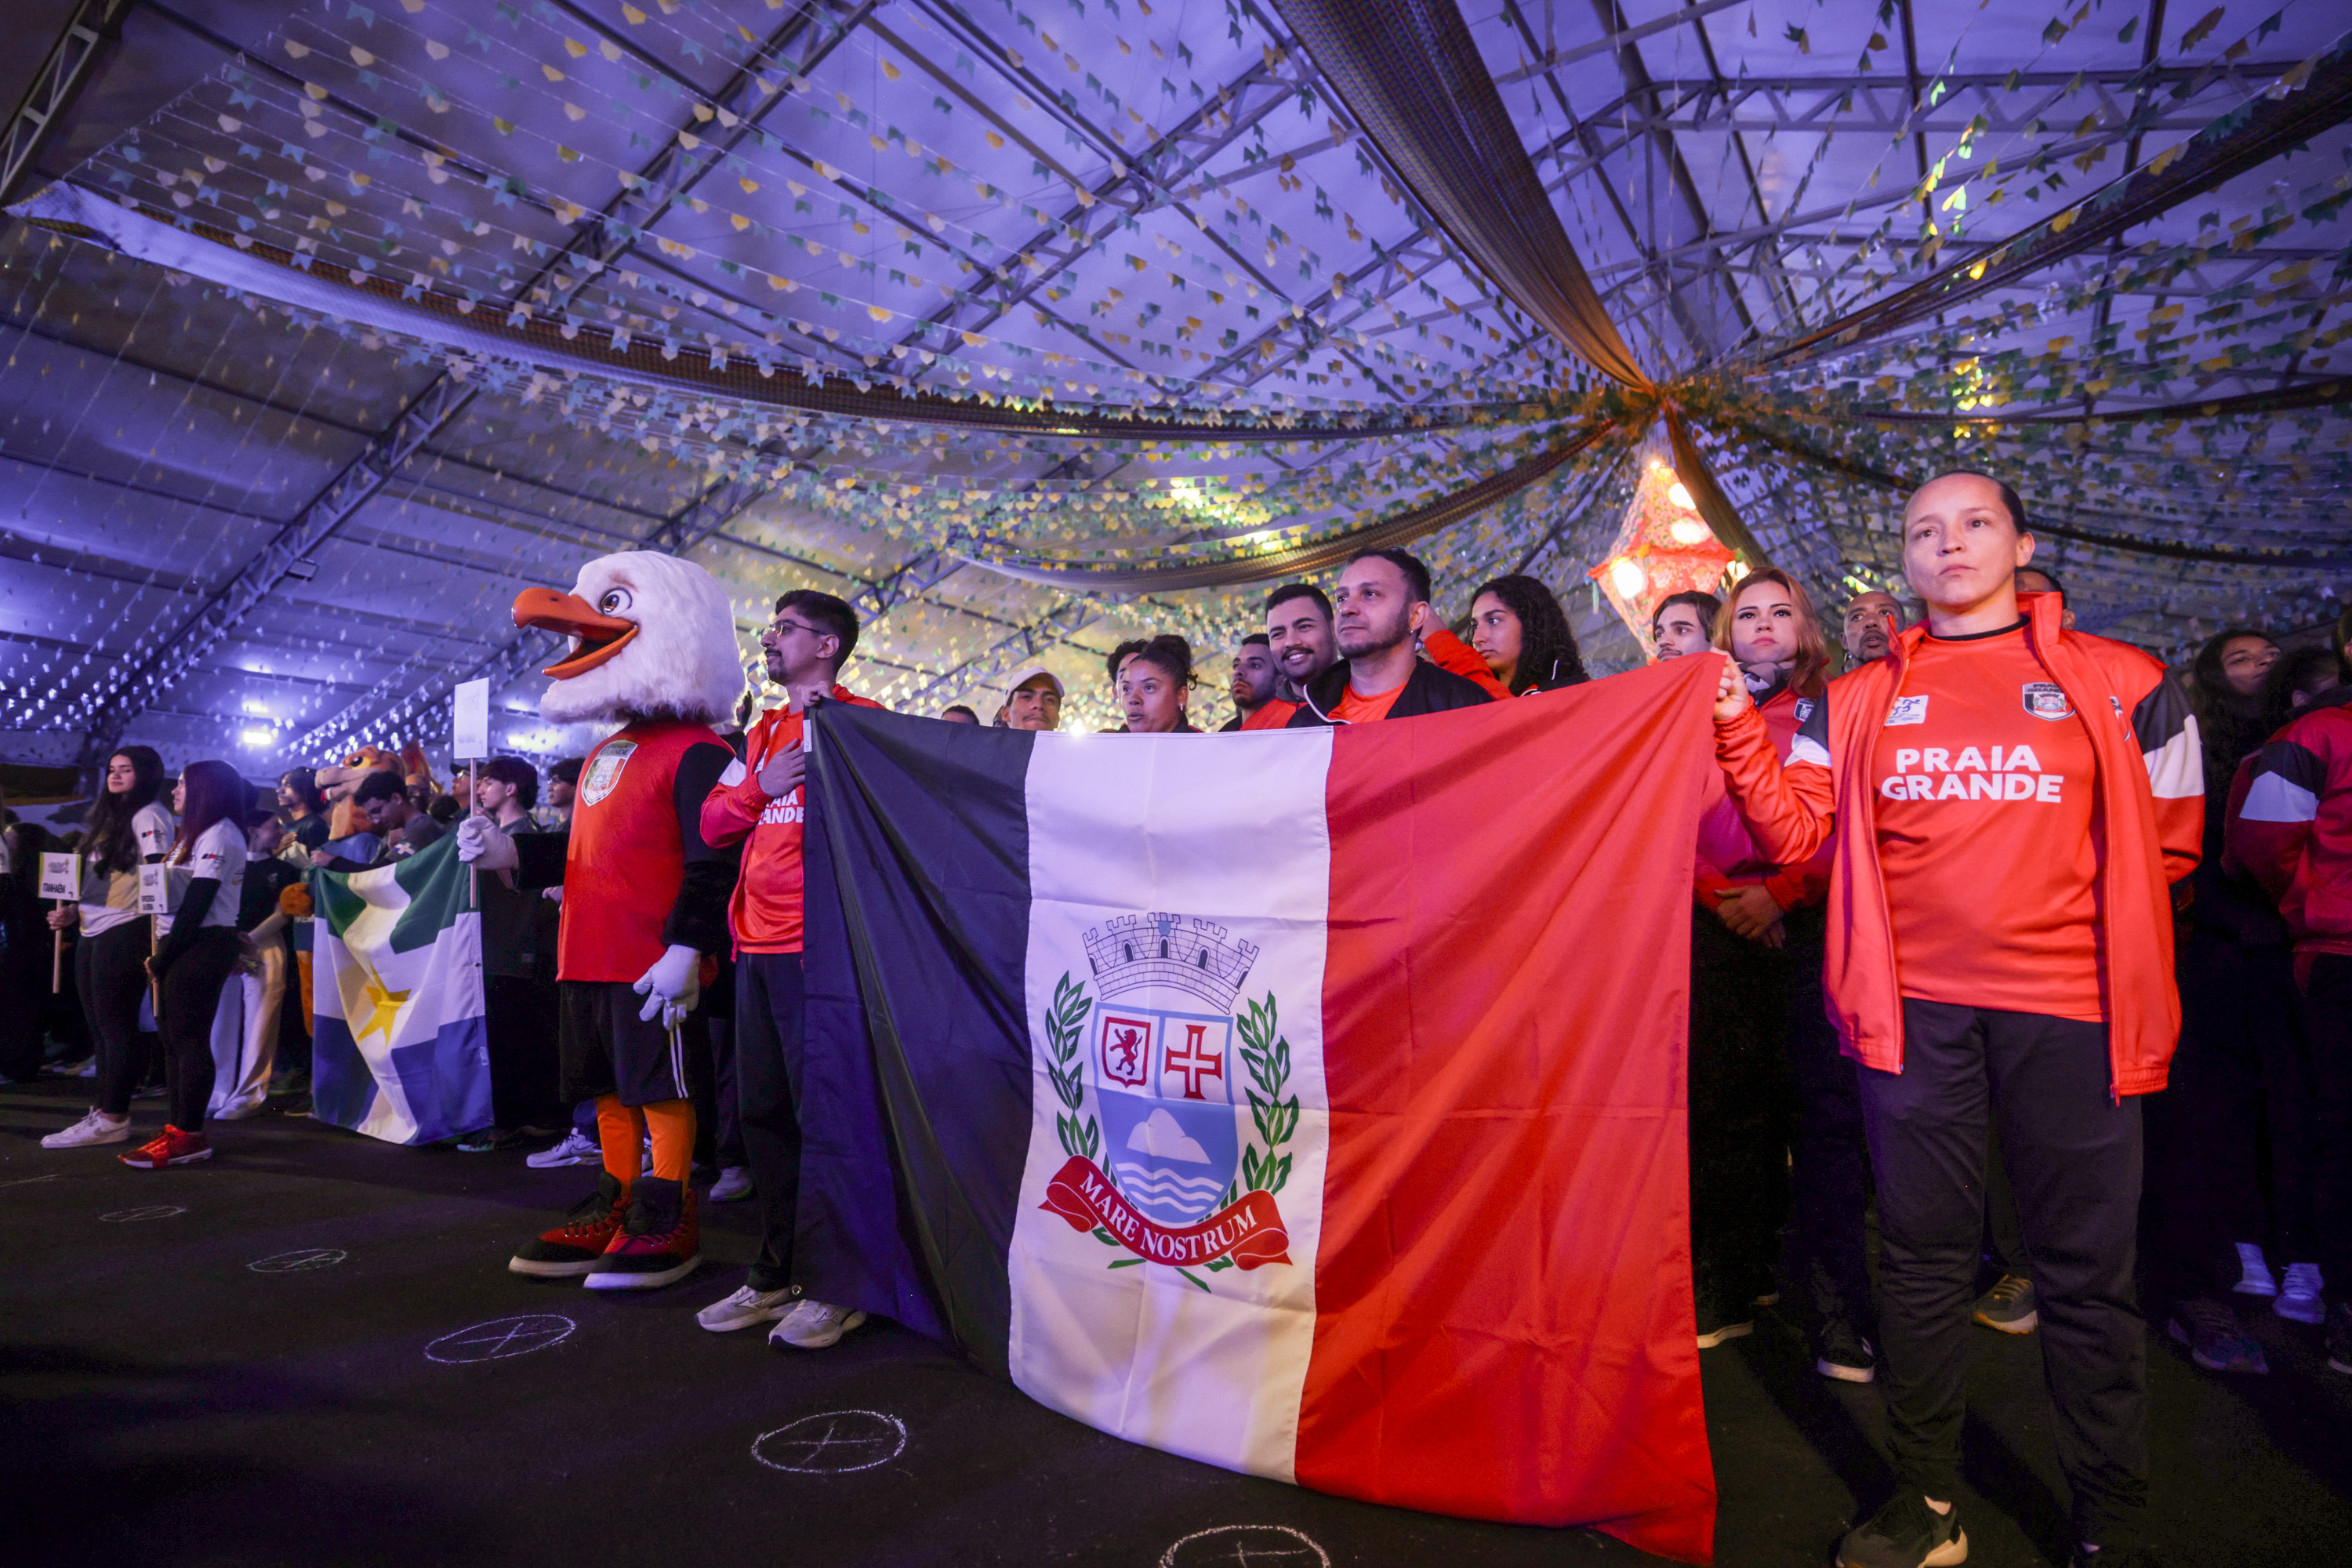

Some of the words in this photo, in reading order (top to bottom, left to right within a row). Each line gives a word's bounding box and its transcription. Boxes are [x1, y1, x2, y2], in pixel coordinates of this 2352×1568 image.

[1896, 745, 2042, 773] PRAIA
[766, 789, 799, 808] AIA
[1881, 773, 2064, 803] GRANDE
[758, 806, 804, 826] ANDE
[1080, 1171, 1139, 1242] MARE
[1140, 1205, 1258, 1261] NOSTRUM
